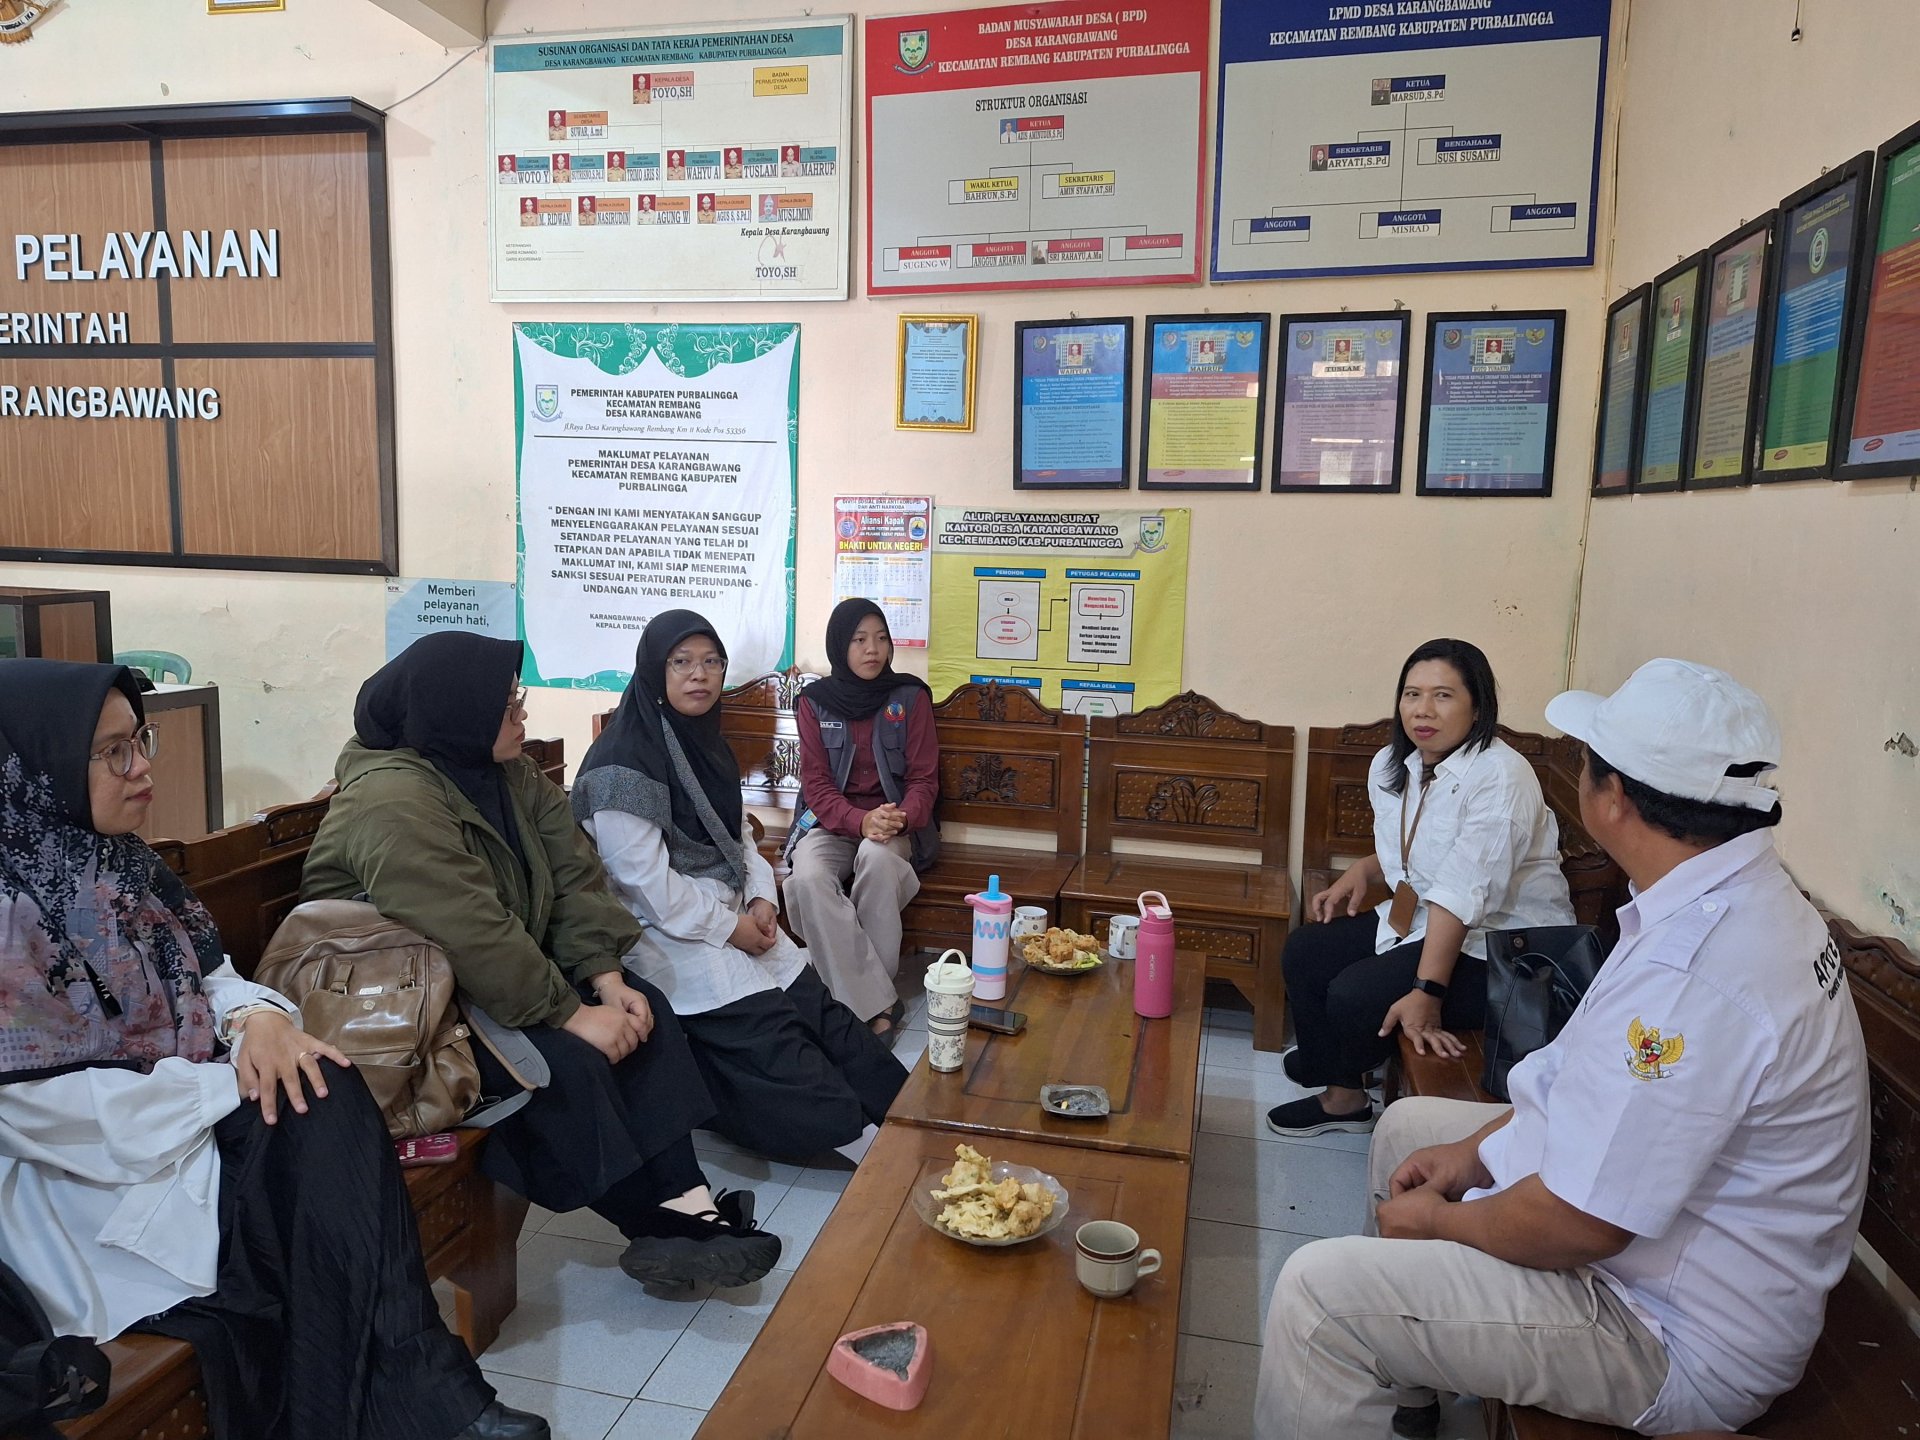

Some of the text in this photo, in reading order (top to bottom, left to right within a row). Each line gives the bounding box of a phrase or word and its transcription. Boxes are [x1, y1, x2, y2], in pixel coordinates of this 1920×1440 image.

[1329, 0, 1492, 21] LPMD DESA KARANGBAWANG
[978, 21, 1011, 34] BADAN
[1014, 15, 1083, 32] MUSYAWARAH
[1085, 12, 1113, 26] DESA
[1270, 11, 1554, 46] KECAMATAN REMBANG KABUPATEN PURBALINGGA
[538, 32, 794, 56] SUSUNAN ORGANISASI DAN TATA KERJA PEMERINTAHAN DESA
[1005, 30, 1118, 50] DESA KARANGBAWANG
[544, 46, 787, 68] DESA KARANGBAWANG KECAMATAN REMBANG KABUPATEN PURBALINGGA
[938, 42, 1190, 73] KECAMATAN REMBANG KABUPATEN PURBALINGGA
[1406, 80, 1430, 88] KETUA
[652, 86, 692, 100] TOYO,SH
[1391, 91, 1444, 102] MARSUD,S.Pd
[976, 92, 1088, 112] STRUKTUR ORGANISASI
[1030, 120, 1051, 128] KETUA
[1336, 145, 1383, 154] SEKRETARIS
[1444, 138, 1493, 148] BENDAHARA
[1328, 156, 1387, 168] ARYATI,S.Pd
[1437, 150, 1500, 163] SUSI SUSANTI
[686, 166, 712, 180] WAHYU
[744, 164, 778, 178] TUSLAM
[802, 162, 835, 176] MAHRUP
[518, 171, 542, 184] WOTO
[1064, 175, 1104, 184] SEKRETARIS
[970, 180, 1013, 190] WAKIL KETUA
[1060, 187, 1074, 196] AMIN
[656, 210, 680, 224] AGUNG
[716, 210, 730, 222] AGUS
[778, 208, 811, 222] MUSLIMIN
[1392, 213, 1427, 222] ANGGOTA
[1526, 206, 1562, 216] ANGGOTA
[548, 212, 570, 226] RIDWAN
[1264, 220, 1297, 229] ANGGOTA
[740, 226, 830, 239] Kepala Desa Karangbawang
[1391, 225, 1430, 234] MISRAD
[1060, 241, 1090, 250] ANGGOTA
[1139, 238, 1170, 246] ANGGOTA
[15, 228, 281, 281] PELAYANAN
[984, 246, 1014, 254] ANGGOTA
[973, 255, 1025, 266] ANGGUN ARIAWAN
[1049, 253, 1060, 262] SRI
[903, 260, 948, 270] SUGENG W
[756, 266, 797, 280] TOYO,SH
[570, 388, 738, 400] PEMERINTAH KABUPATEN PURBALINGGA
[0, 386, 220, 420] RANGBAWANG
[606, 400, 701, 409] KECAMATAN REMBANG
[606, 410, 702, 419] DESA KARANGBAWANG
[602, 424, 645, 433] Karangbawang
[647, 426, 675, 434] Rembang
[696, 426, 712, 434] Kode
[714, 426, 724, 434] Pos
[598, 450, 710, 461] MAKLUMAT PELAYANAN
[568, 459, 741, 472] PEMERINTAH DESA KARANGBAWANG
[572, 470, 737, 483] KECAMATAN REMBANG KABUPATEN
[618, 482, 688, 492] PURBALINGGA
[555, 506, 762, 522] DENGAN INI KAMI MENYATAKAN SANGGUP
[964, 512, 1098, 524] ALUR PELAYANAN SURAT
[551, 519, 759, 536] MENYELENGGARAKAN PELAYANAN SESUAI
[884, 516, 904, 526] Kapak
[946, 524, 1118, 536] KANTOR DESA KARANGBAWANG
[560, 532, 748, 548] SETANDAR PELAYANAN YANG TELAH DI
[840, 541, 923, 551] BHAKTI UNTUK NEGERI
[940, 535, 1123, 549] KEC.REMBANG KAB.PURBALINGGA
[554, 545, 755, 562] TETAPKAN DAN APABILA TIDAK MENEPATI
[561, 558, 747, 575] MAKLUMAT INI, KAMI SIAP MENERIMA
[551, 570, 752, 588] SANKSI SESUAI PERATURAN PERUNDANG
[428, 584, 476, 596] Memberi
[583, 584, 716, 599] UNDANGAN YANG BERLAKU
[424, 599, 480, 612] pelayanan
[417, 614, 490, 627] sepenuh hati,
[590, 614, 648, 622] KARANGBAWANG,
